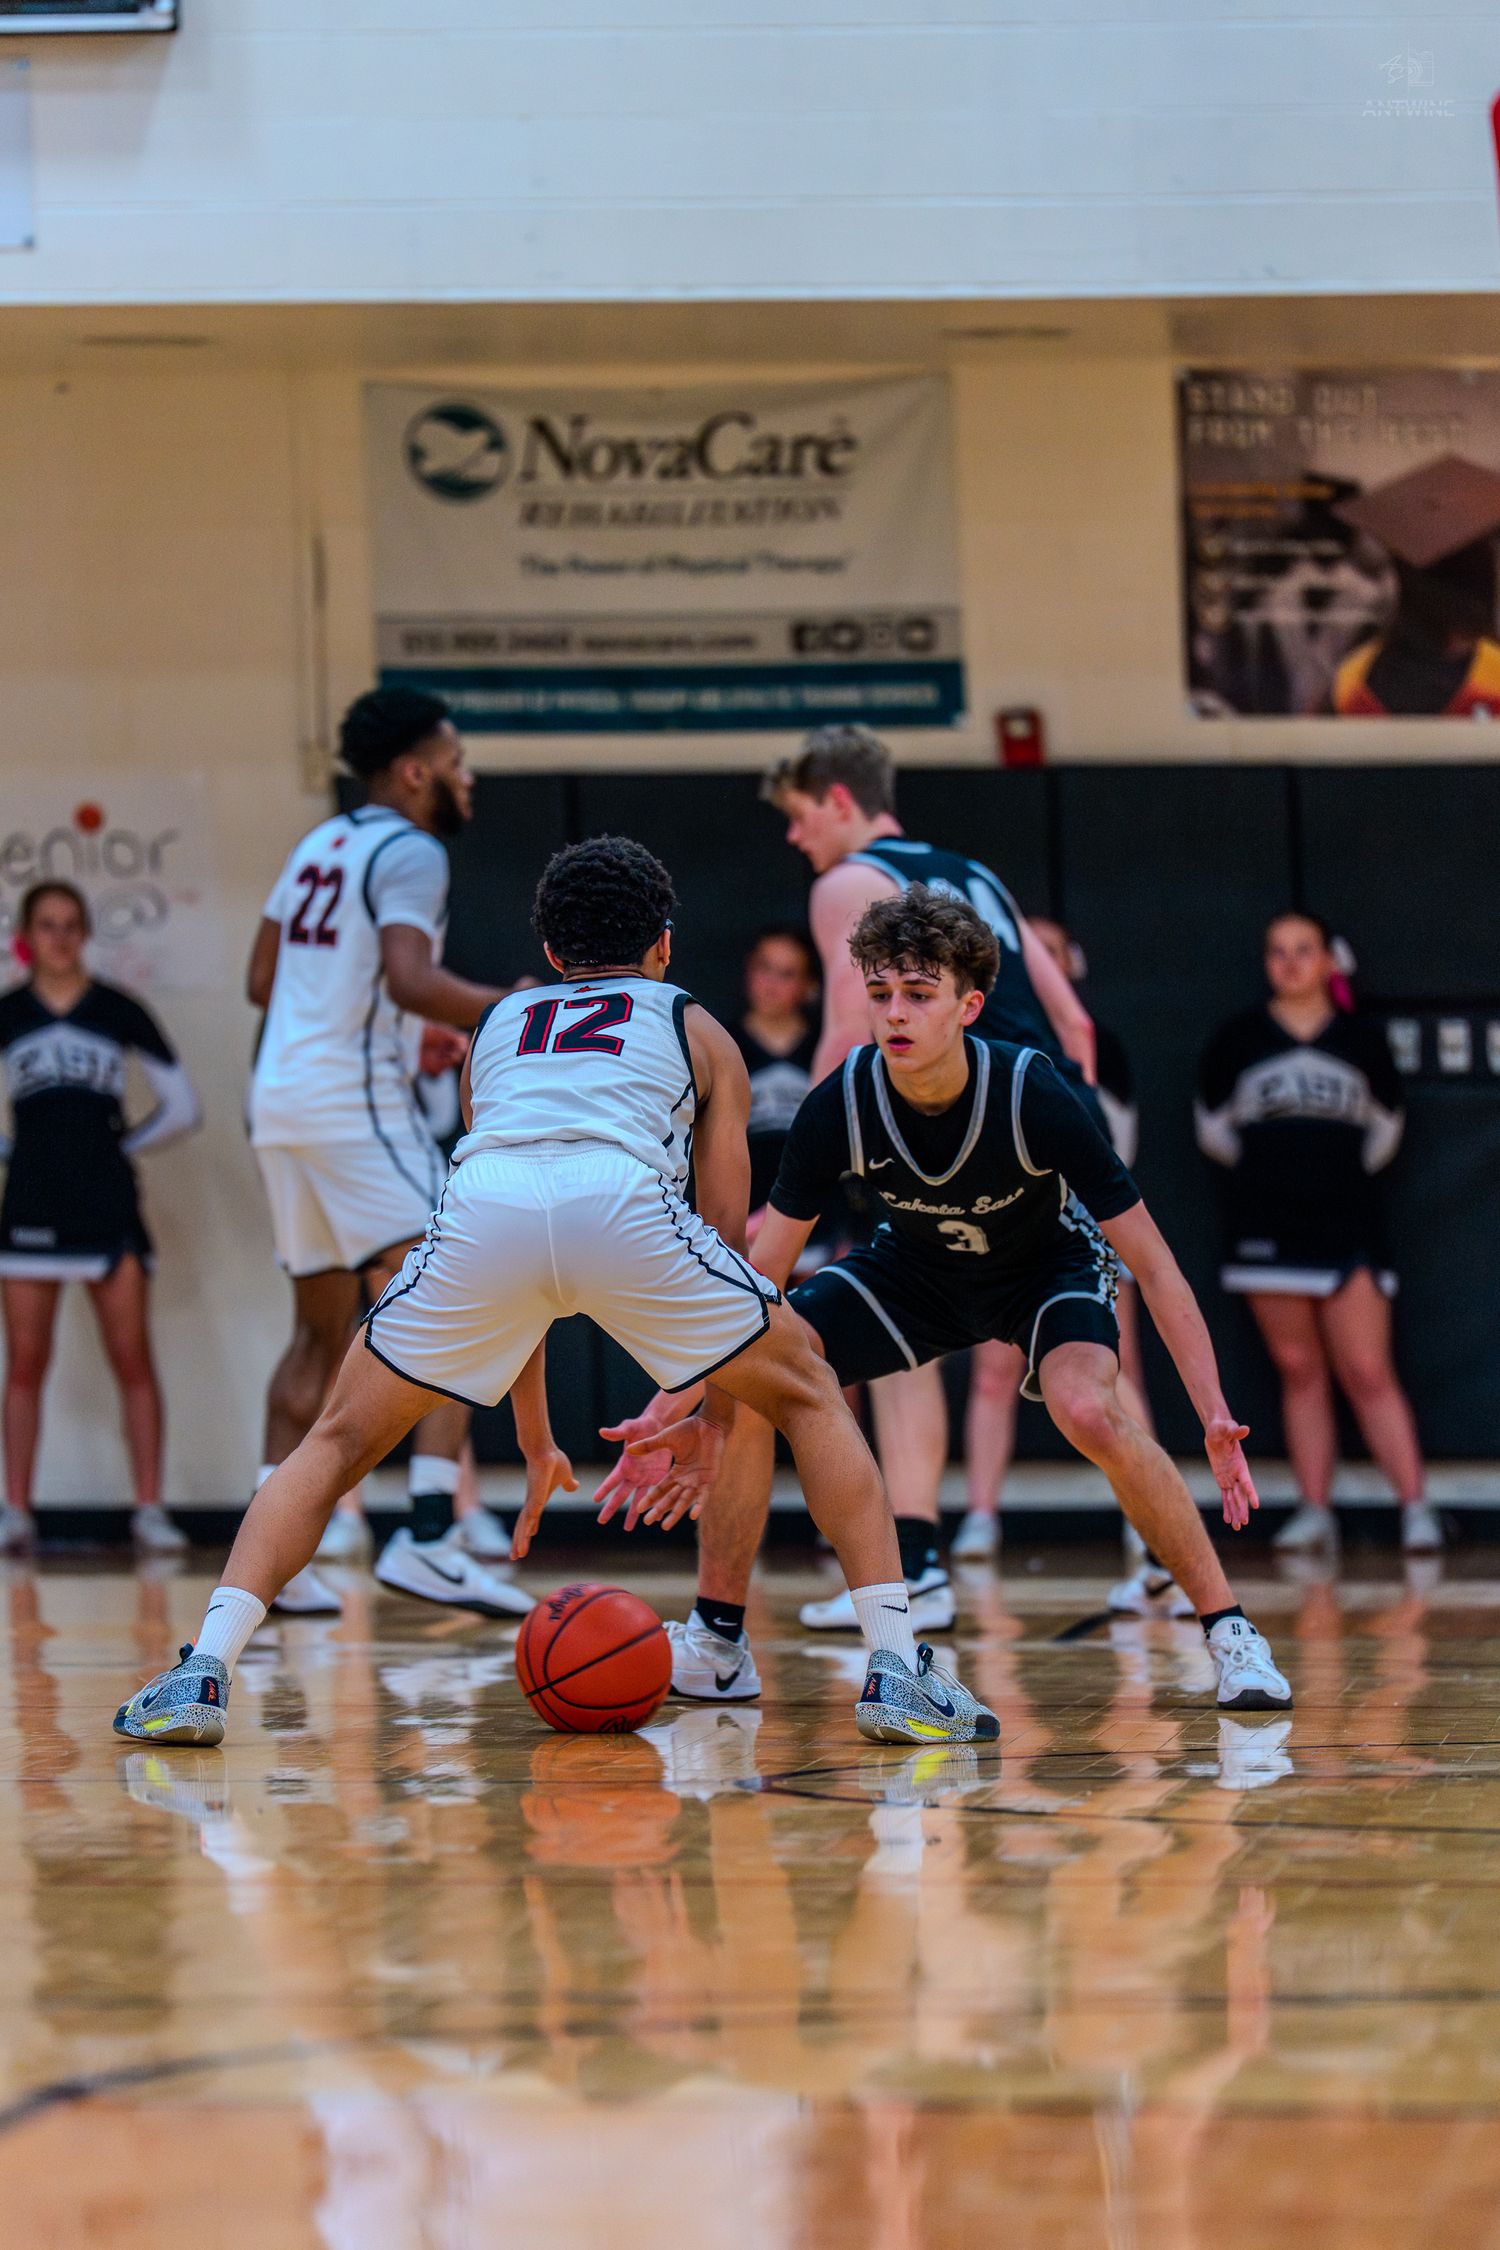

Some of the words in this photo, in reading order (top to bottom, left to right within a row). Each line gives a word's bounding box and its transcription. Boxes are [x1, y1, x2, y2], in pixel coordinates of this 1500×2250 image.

[518, 409, 857, 483] NovaCare
[289, 864, 343, 945] 22
[516, 991, 634, 1058] 12
[937, 1219, 991, 1256] 3
